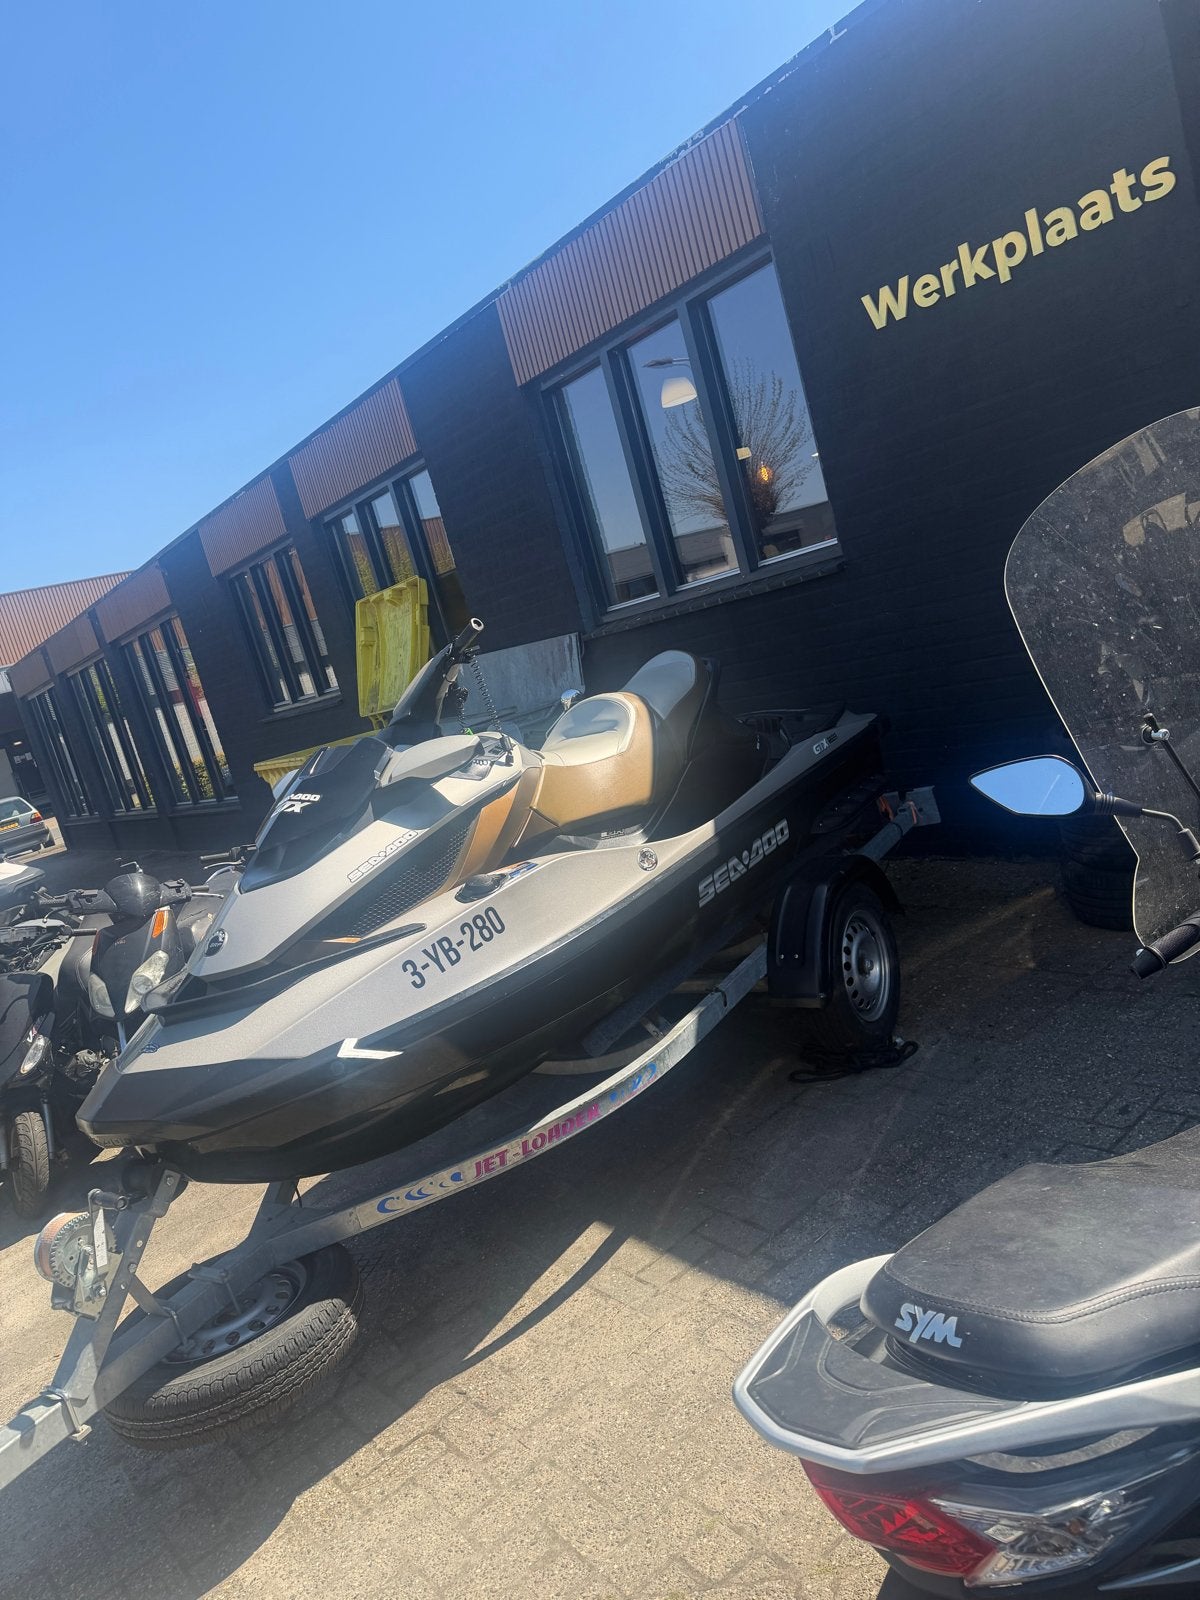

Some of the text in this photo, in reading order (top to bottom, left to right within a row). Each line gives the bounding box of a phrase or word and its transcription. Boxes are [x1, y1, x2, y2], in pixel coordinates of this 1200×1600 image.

[860, 156, 1176, 330] Werkplaats
[402, 905, 506, 990] 3-YB-280
[894, 1302, 963, 1349] SYM
